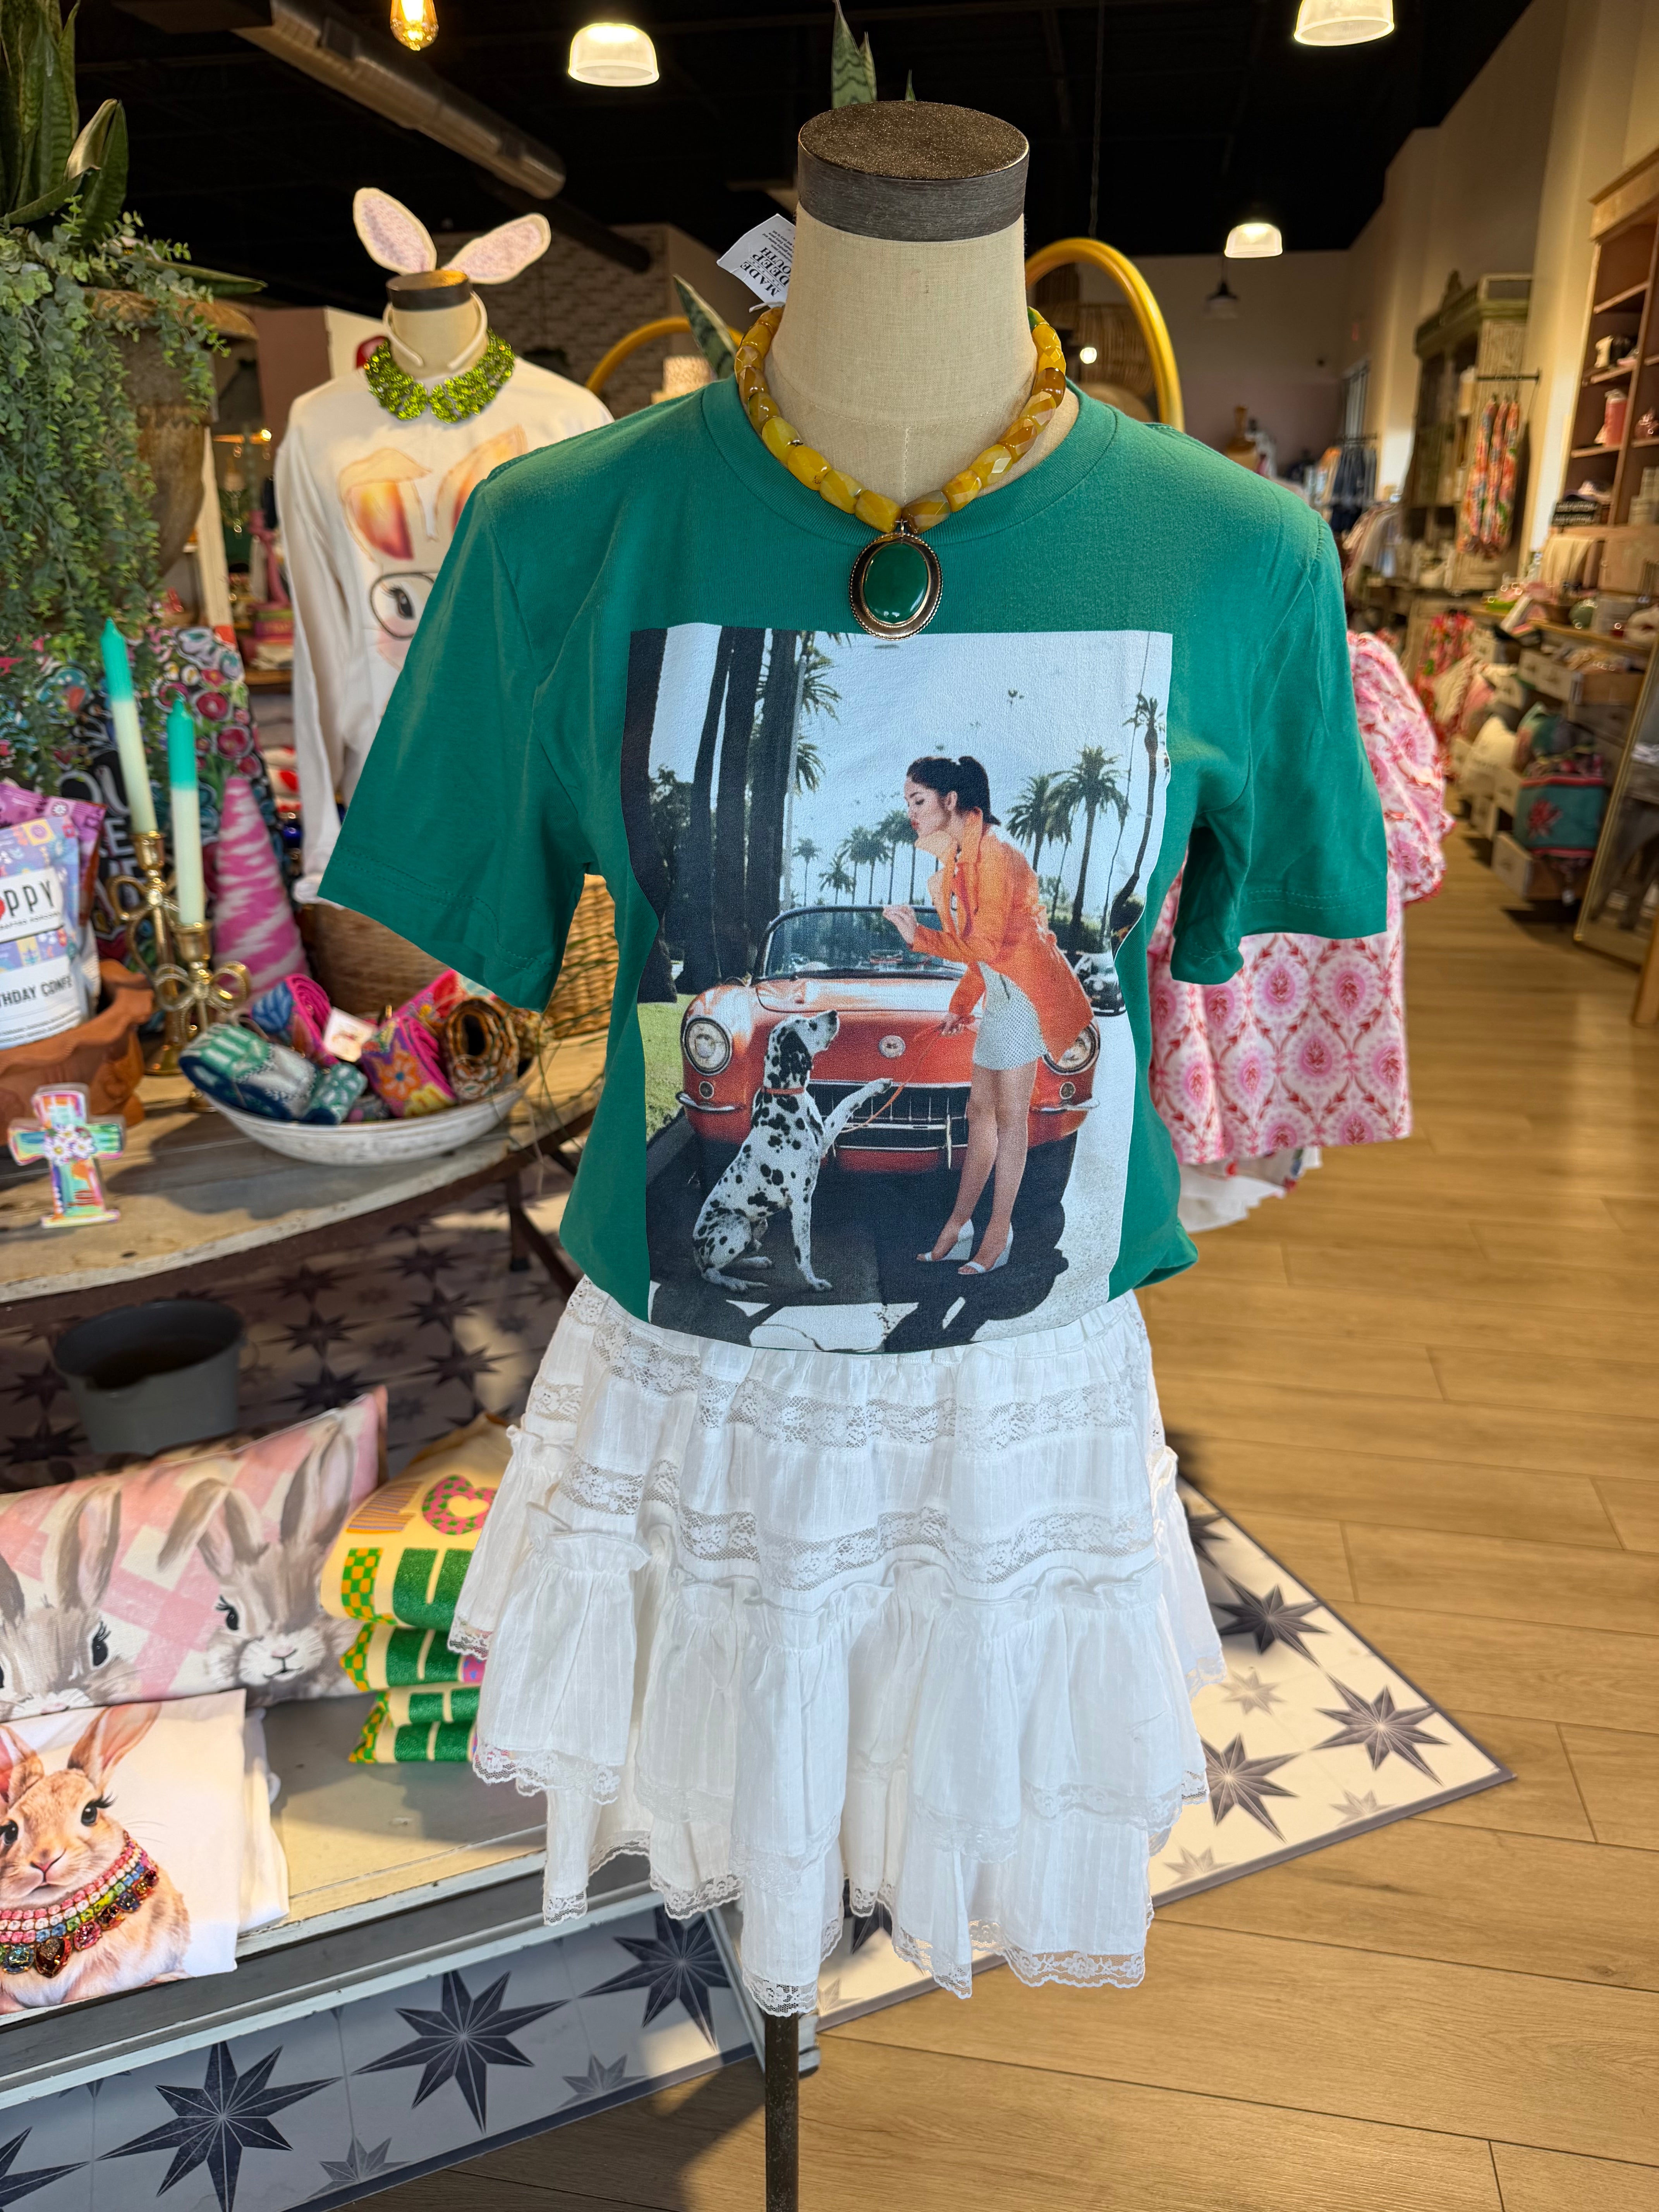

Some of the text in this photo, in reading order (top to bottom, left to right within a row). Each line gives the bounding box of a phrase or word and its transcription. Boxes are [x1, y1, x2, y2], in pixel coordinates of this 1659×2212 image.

[752, 254, 789, 286] DEEP
[759, 247, 791, 276] OUTH
[740, 261, 780, 297] MADE
